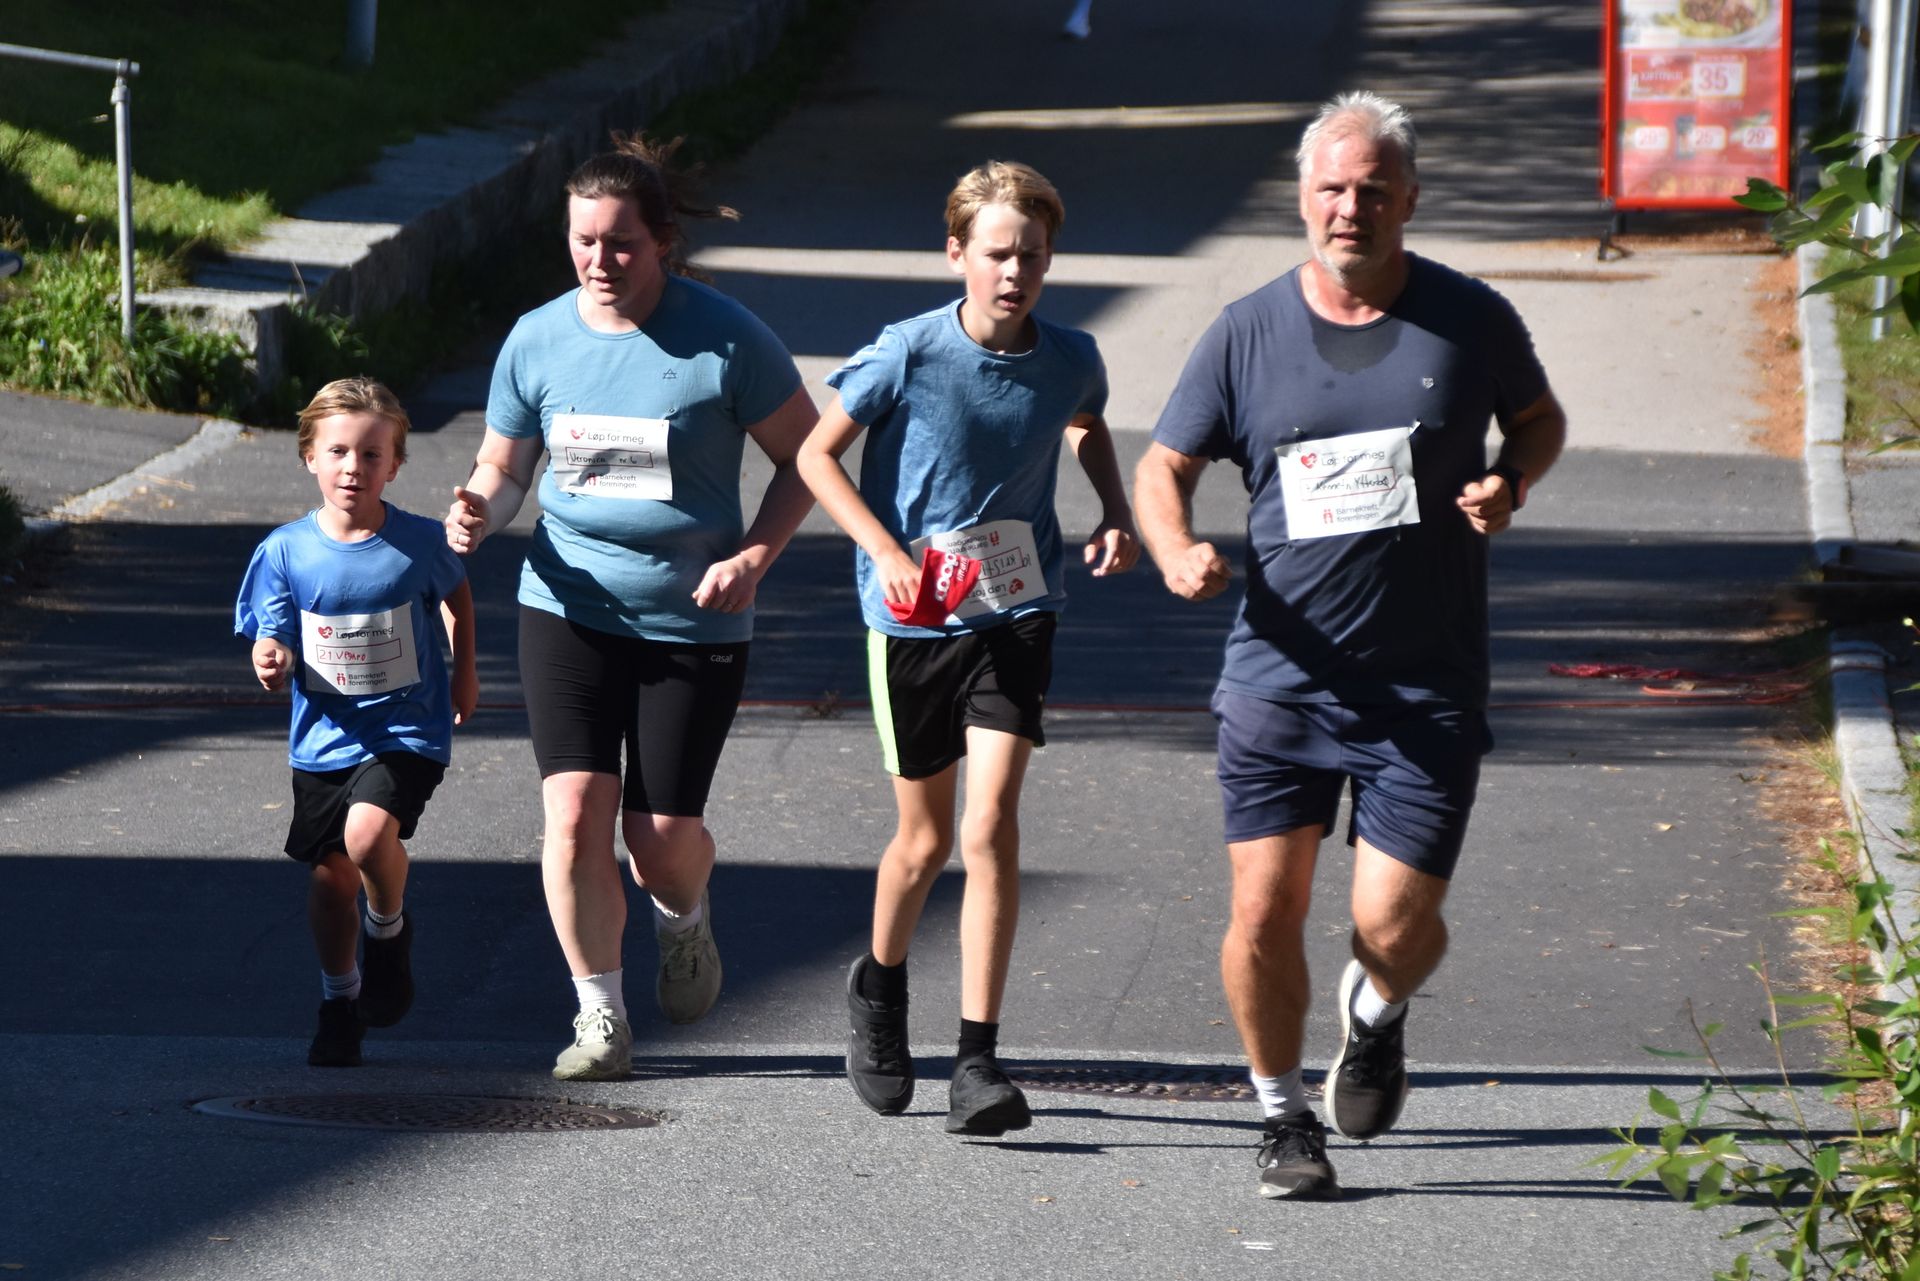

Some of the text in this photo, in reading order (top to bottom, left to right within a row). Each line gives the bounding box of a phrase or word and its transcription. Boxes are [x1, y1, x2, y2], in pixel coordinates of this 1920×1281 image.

[588, 432, 644, 444] Løp for meg
[935, 553, 958, 602] coop
[988, 584, 1006, 593] Løp
[336, 631, 354, 639] Løp
[356, 630, 370, 638] for
[372, 626, 394, 638] meg
[320, 650, 332, 660] 21
[349, 671, 386, 680] Barnekreft
